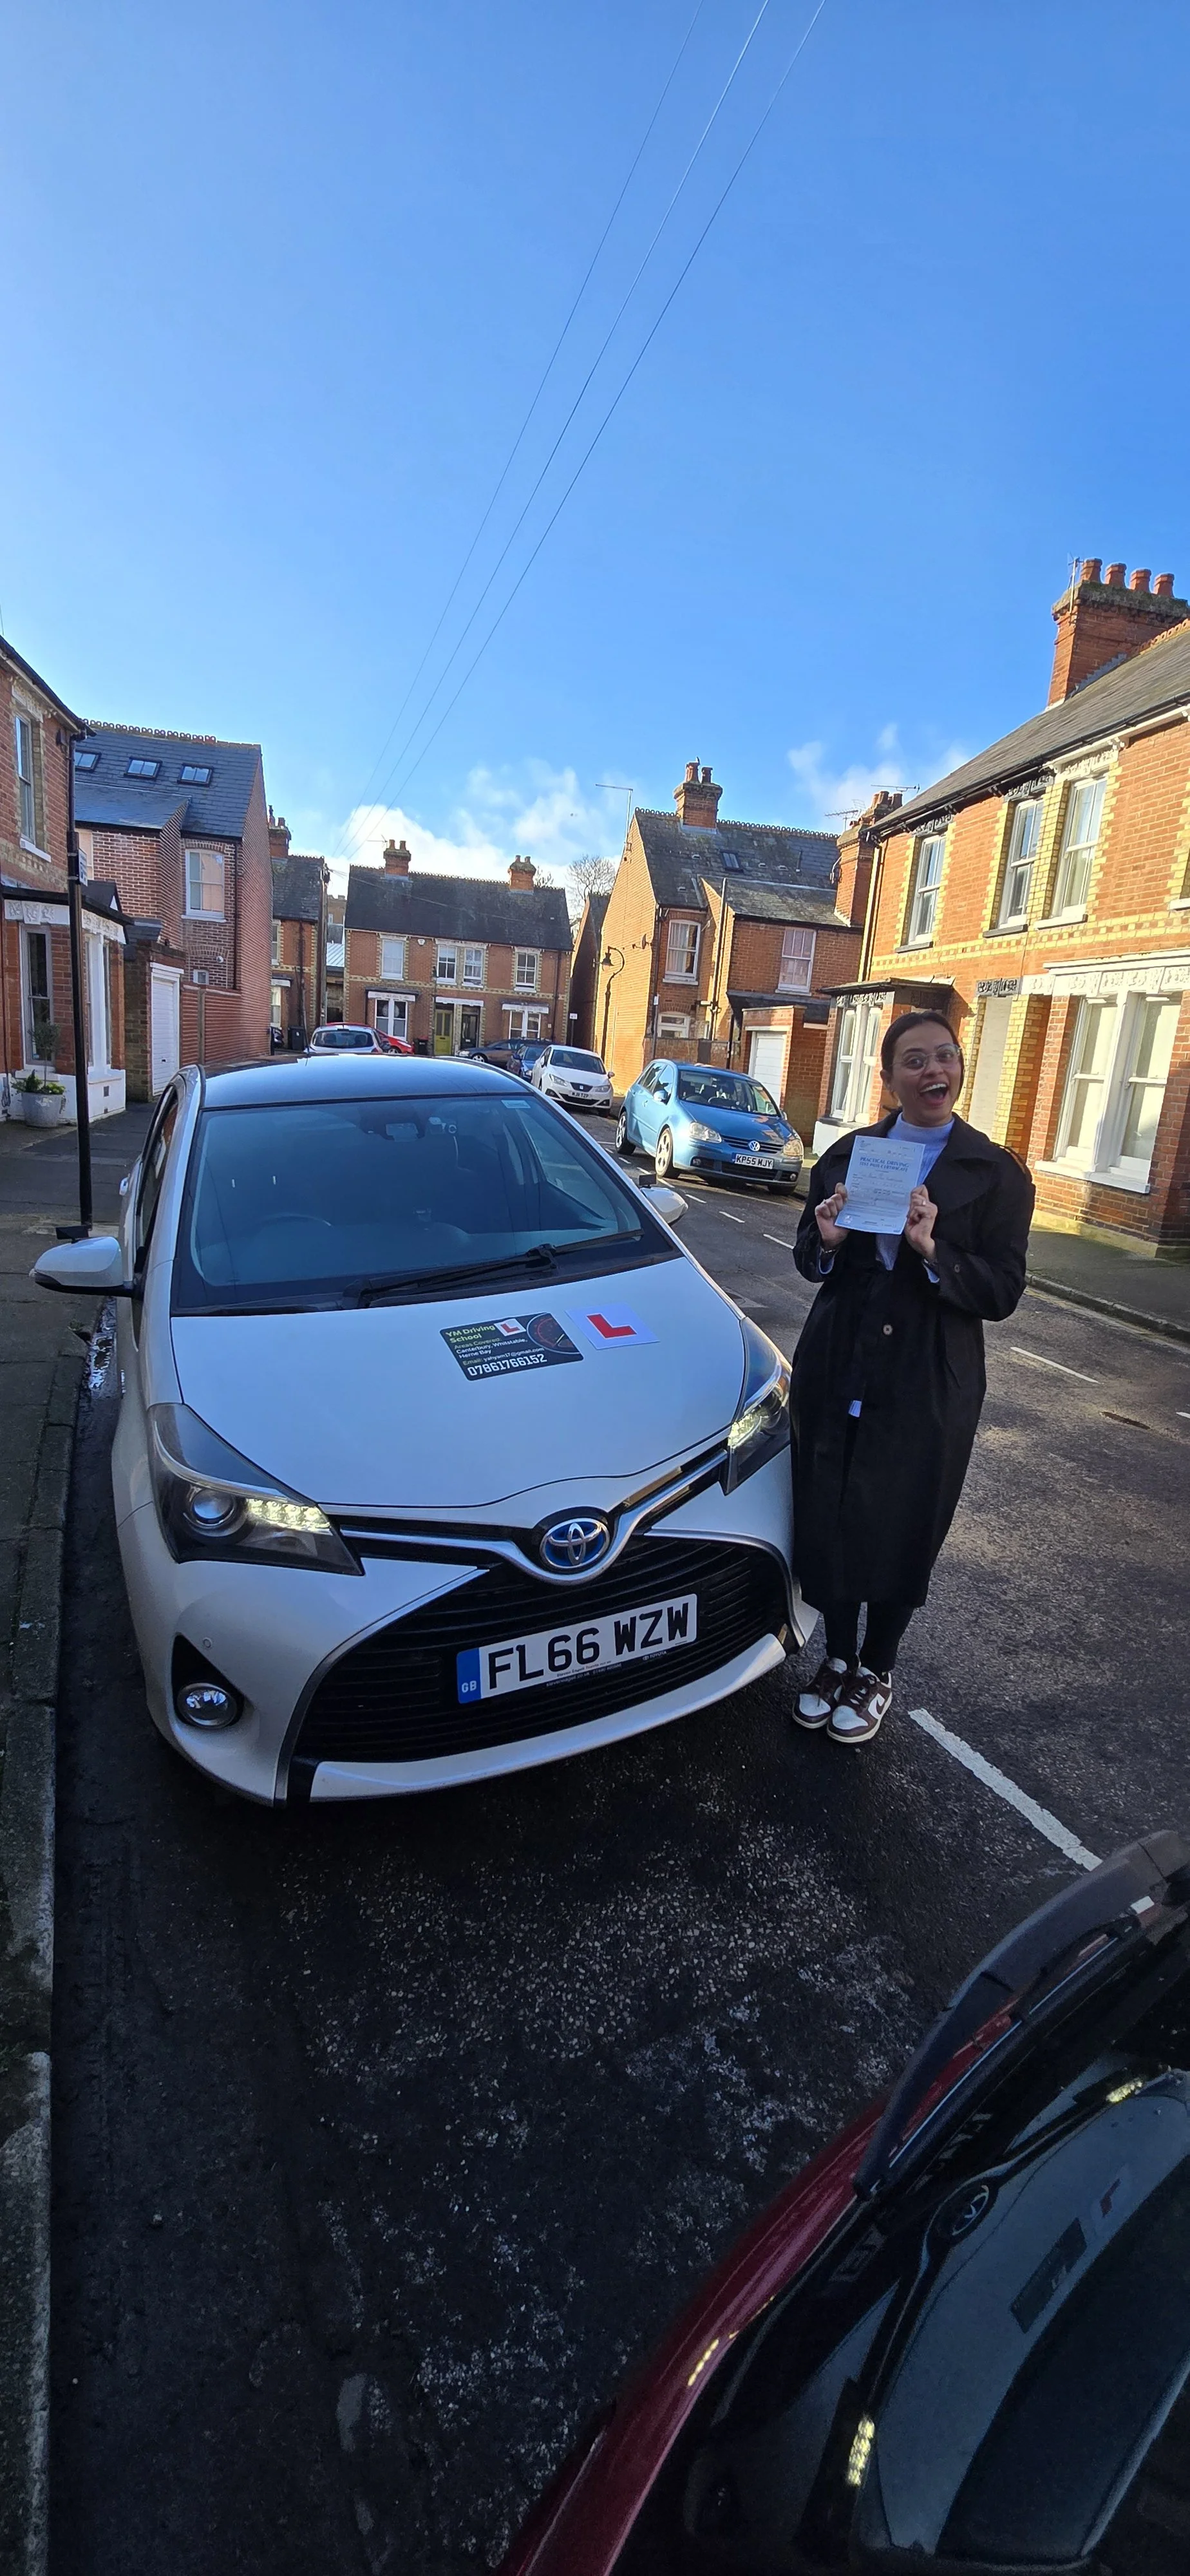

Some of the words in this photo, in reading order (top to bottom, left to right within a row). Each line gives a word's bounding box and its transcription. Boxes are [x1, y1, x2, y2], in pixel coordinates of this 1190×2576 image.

[737, 1155, 756, 1165] KP55
[757, 1159, 772, 1167] MJY
[462, 1325, 496, 1334] Driving
[500, 1323, 520, 1333] L
[587, 1313, 638, 1338] L
[449, 1334, 482, 1343] School
[456, 1343, 493, 1354] Canterbury,
[493, 1338, 528, 1347] Whitstable,
[468, 1354, 547, 1376] 07861766152
[488, 1627, 600, 1690] FL66
[614, 1602, 689, 1656] WZW
[461, 1680, 477, 1693] GB
